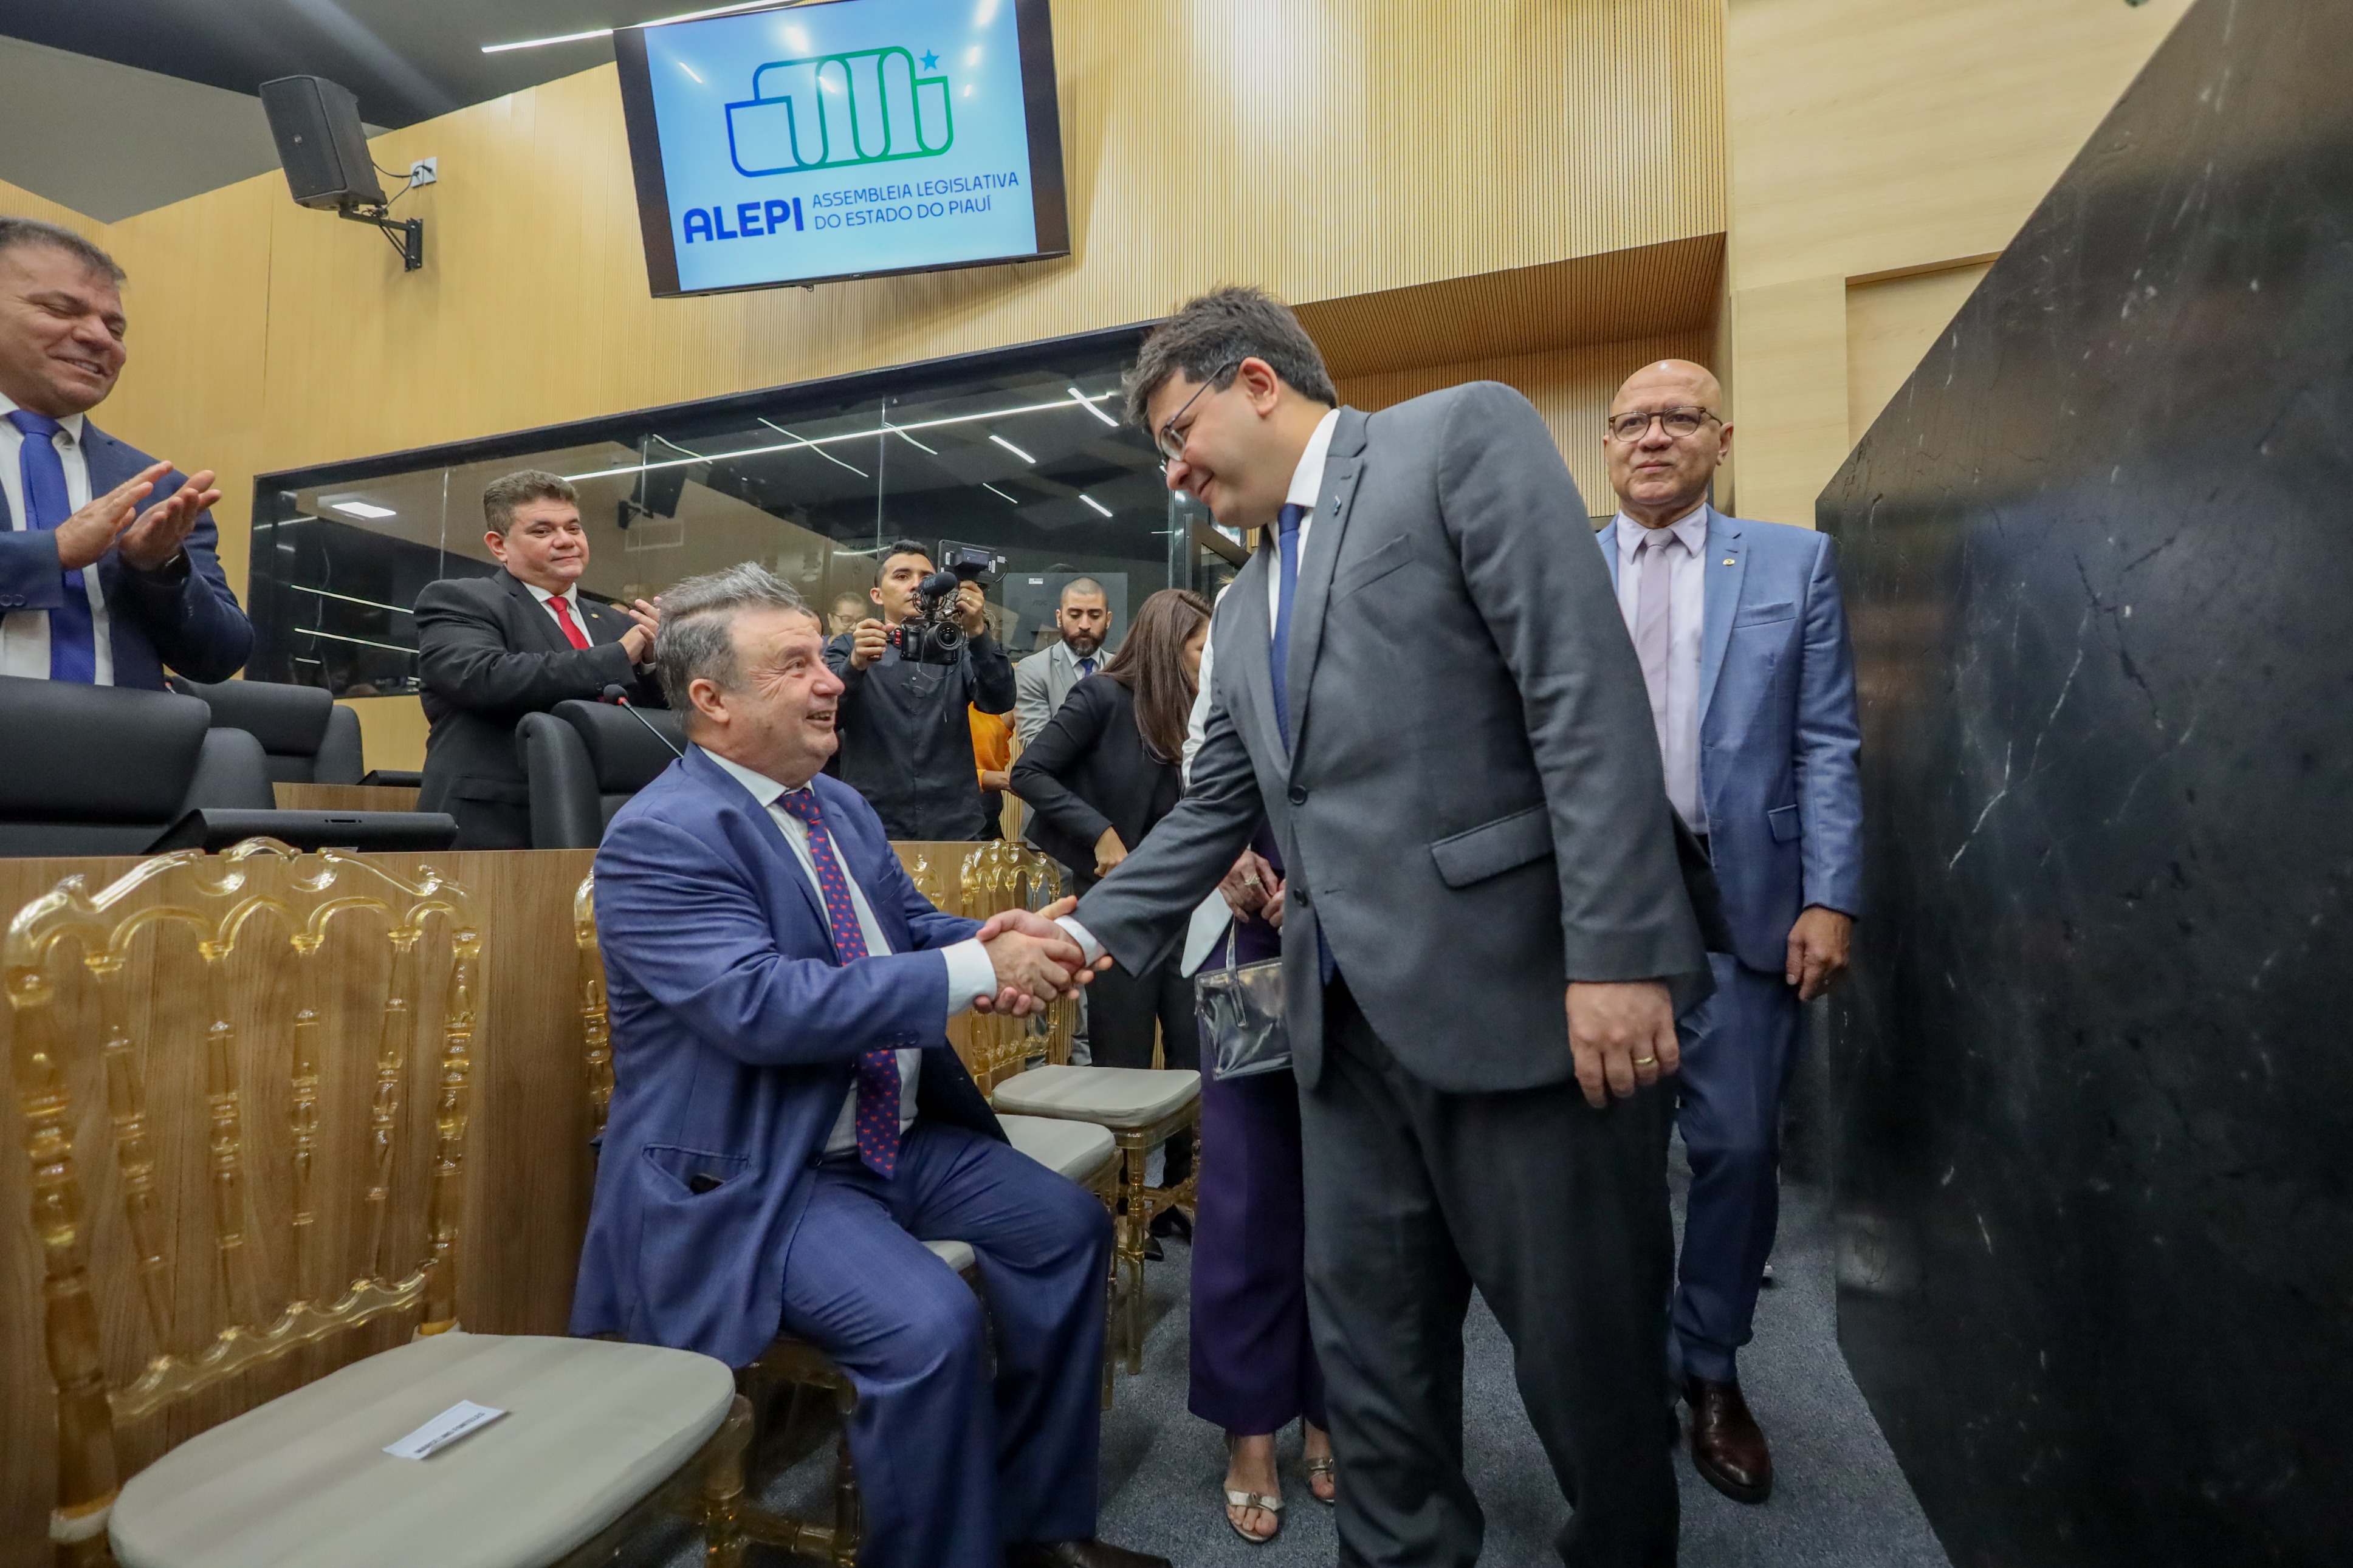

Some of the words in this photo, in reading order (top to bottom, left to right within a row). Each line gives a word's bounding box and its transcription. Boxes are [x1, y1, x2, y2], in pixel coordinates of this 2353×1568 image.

[812, 184, 913, 208] ASSEMBLEIA
[916, 171, 1019, 197] LEGISLATIVA
[682, 197, 805, 244] ALEPI
[814, 214, 841, 230] DO
[845, 206, 913, 227] ESTADO
[917, 203, 944, 219] DO
[949, 195, 991, 215] PIAUÍ
